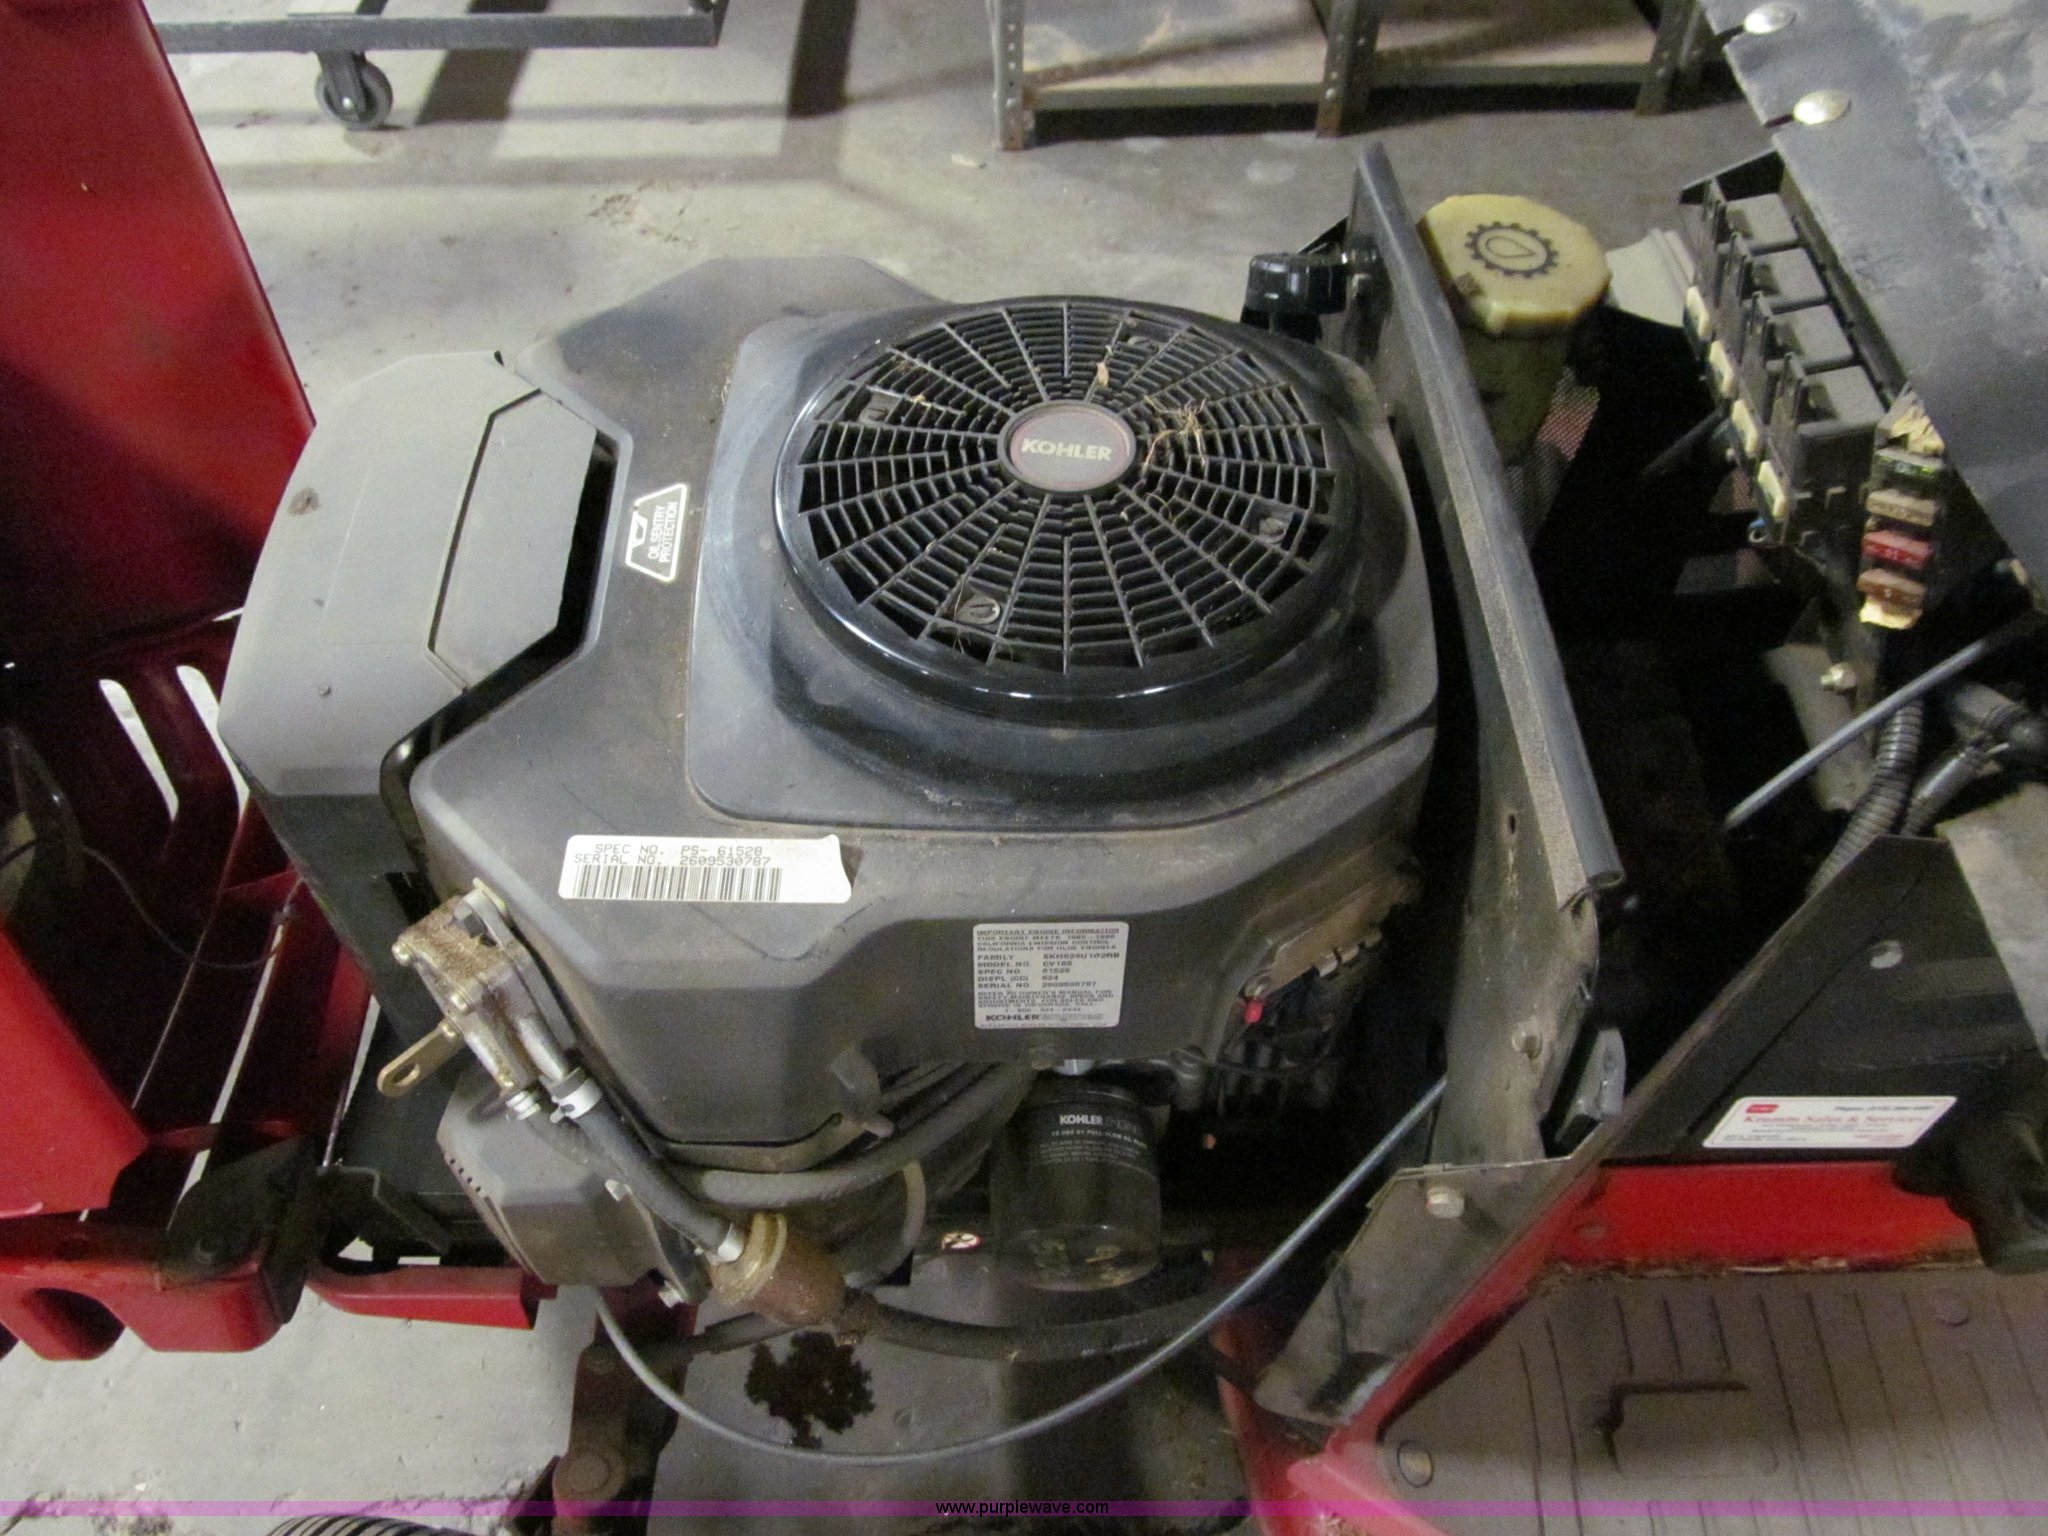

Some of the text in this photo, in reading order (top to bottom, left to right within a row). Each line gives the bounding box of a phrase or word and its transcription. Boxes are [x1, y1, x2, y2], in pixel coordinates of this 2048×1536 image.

[1021, 439, 1112, 461] KOHLER
[647, 505, 666, 560] OIL SENTRY
[658, 501, 679, 563] PROTECTION
[595, 843, 631, 854] SPEC
[640, 844, 665, 856] NO.
[717, 845, 764, 857] 61528
[574, 853, 628, 865] SERIAL
[637, 854, 663, 866] NO.
[985, 1013, 1040, 1021] KOHLER
[1059, 1114, 1104, 1126] KOHLER
